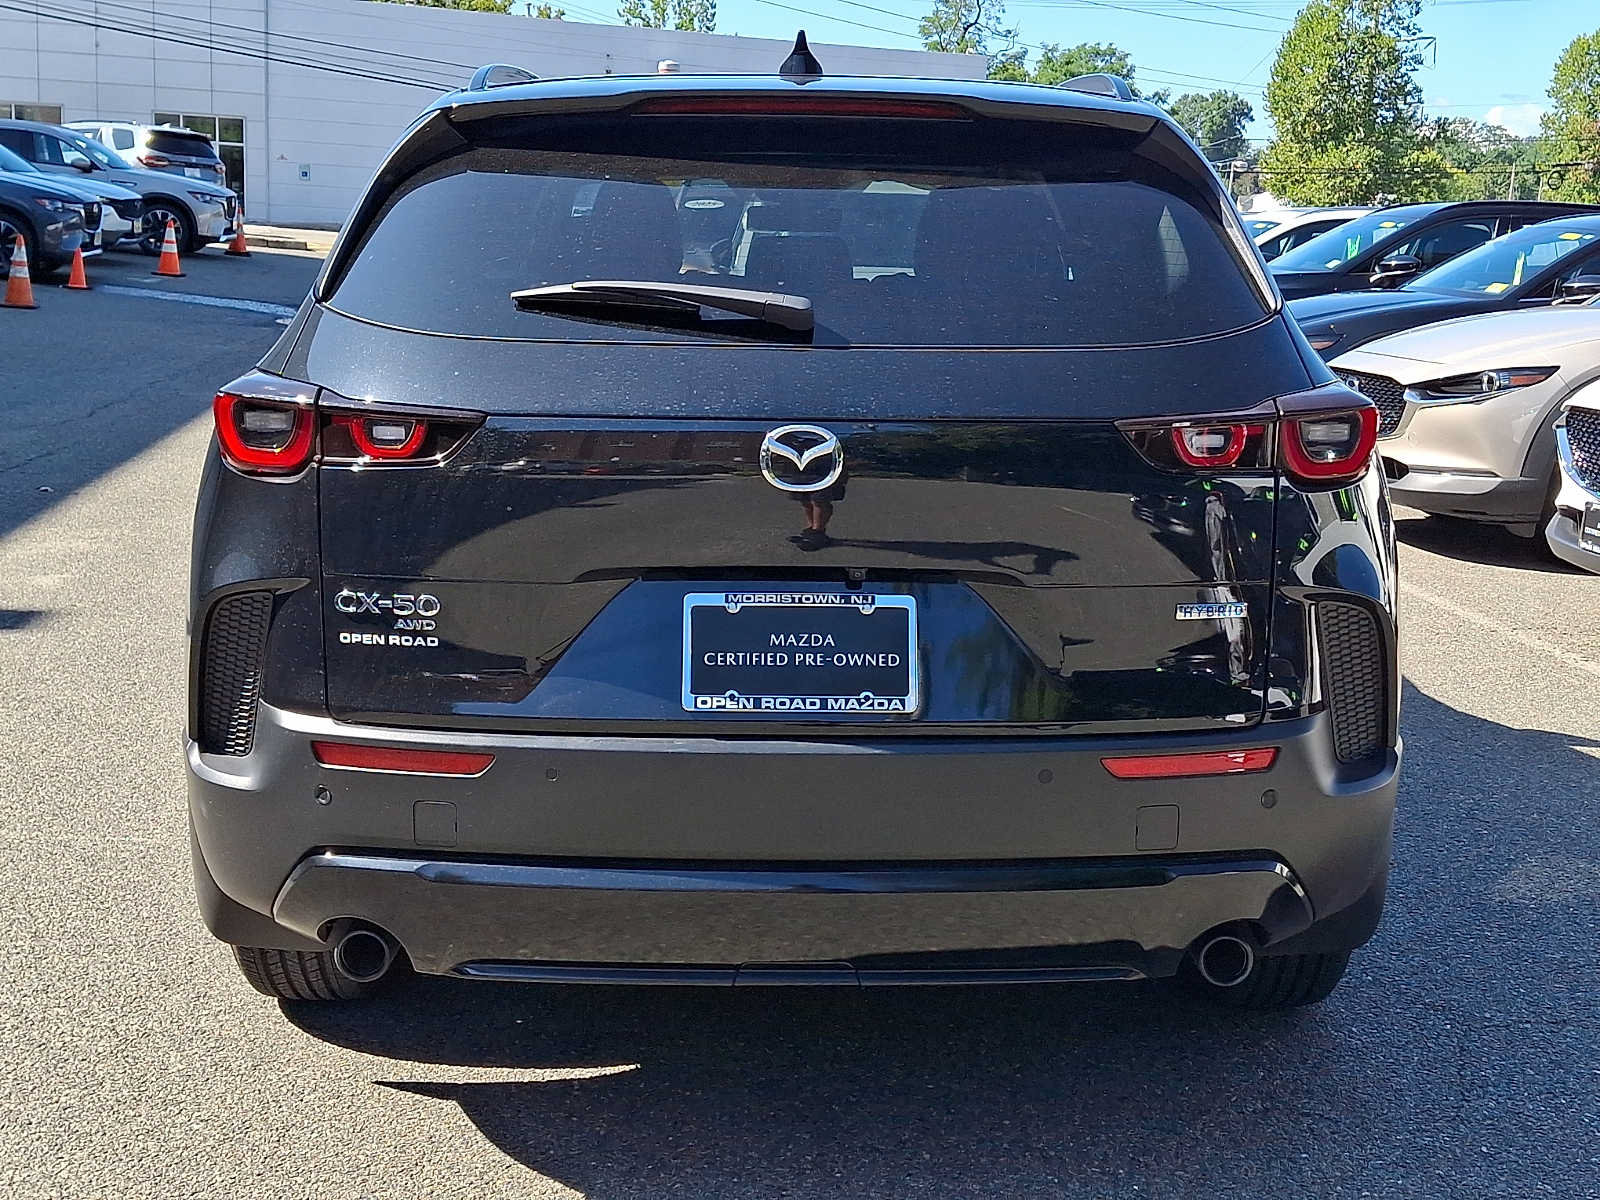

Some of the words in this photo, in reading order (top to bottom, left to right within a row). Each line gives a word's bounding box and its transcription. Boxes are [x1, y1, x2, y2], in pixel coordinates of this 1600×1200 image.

[334, 588, 441, 617] CX-50
[727, 593, 845, 604] MORRISTOWN,
[850, 595, 872, 604] NJ
[1183, 604, 1244, 617] HYBRID
[393, 618, 437, 631] AWD
[339, 632, 386, 645] OPEN
[388, 634, 439, 647] ROAD
[769, 633, 836, 647] MAZDA
[703, 652, 789, 666] CERTIFIED
[795, 653, 901, 667] PRE-OWNED
[696, 696, 755, 709] OPEN
[761, 697, 822, 710] ROAD
[827, 698, 905, 711] MAZDA
